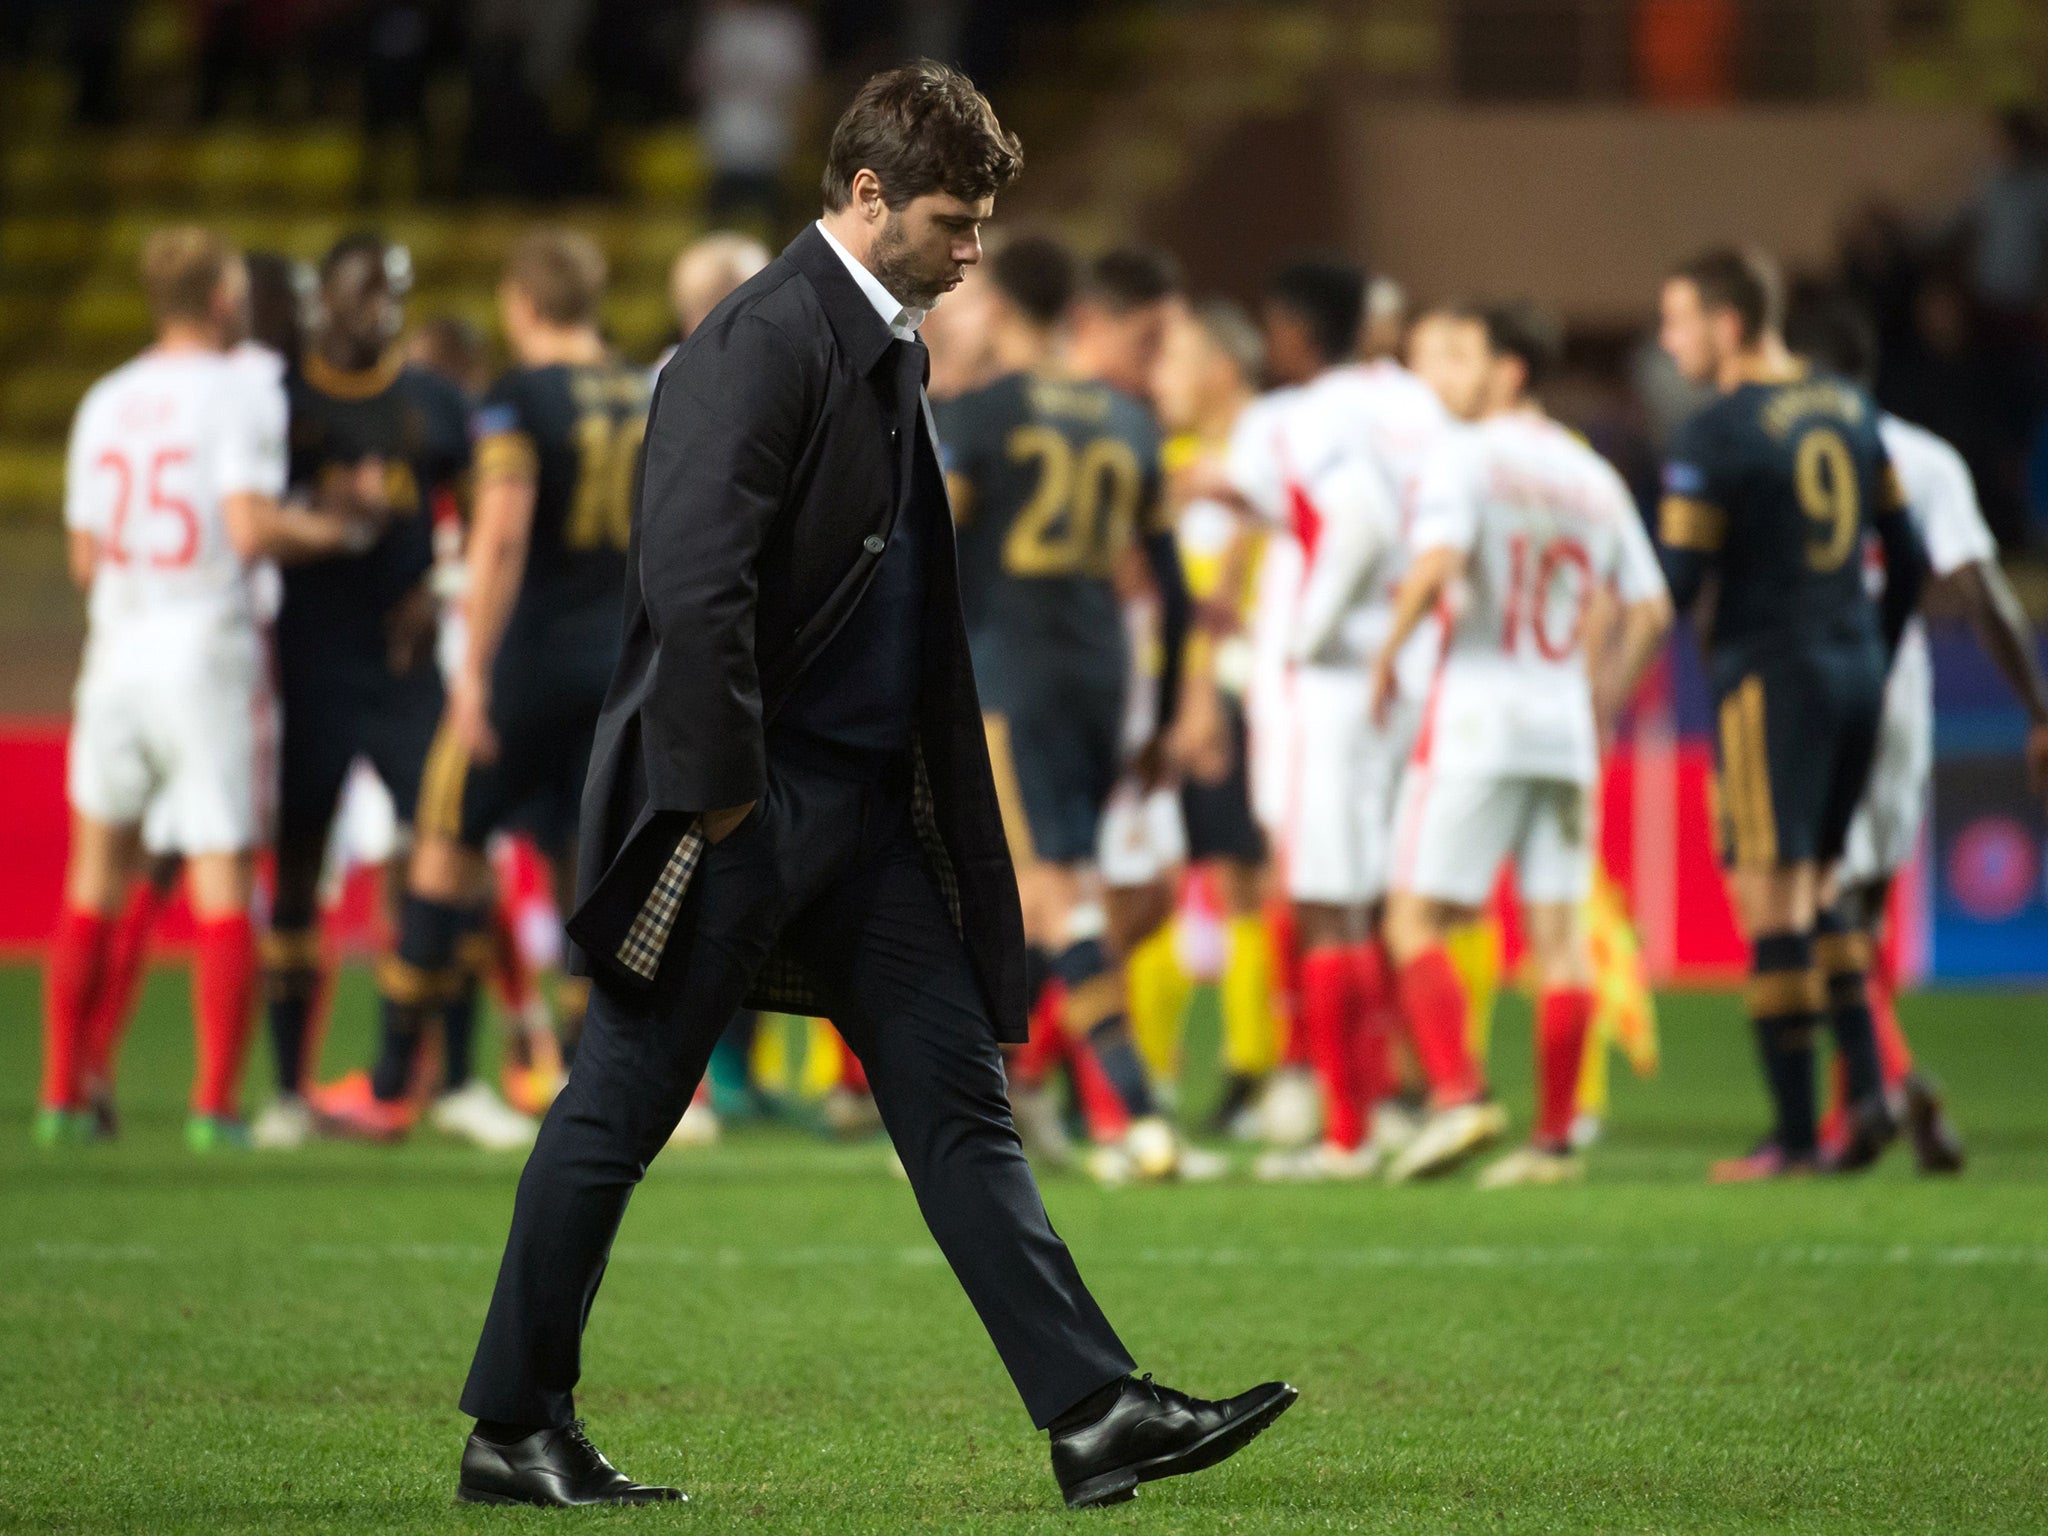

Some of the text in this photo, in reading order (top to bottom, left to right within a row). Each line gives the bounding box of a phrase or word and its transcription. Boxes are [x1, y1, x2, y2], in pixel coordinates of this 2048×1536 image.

[93, 447, 201, 570] 25
[1006, 424, 1139, 577] 20
[1795, 429, 1859, 572] 9
[1501, 533, 1595, 663] 10
